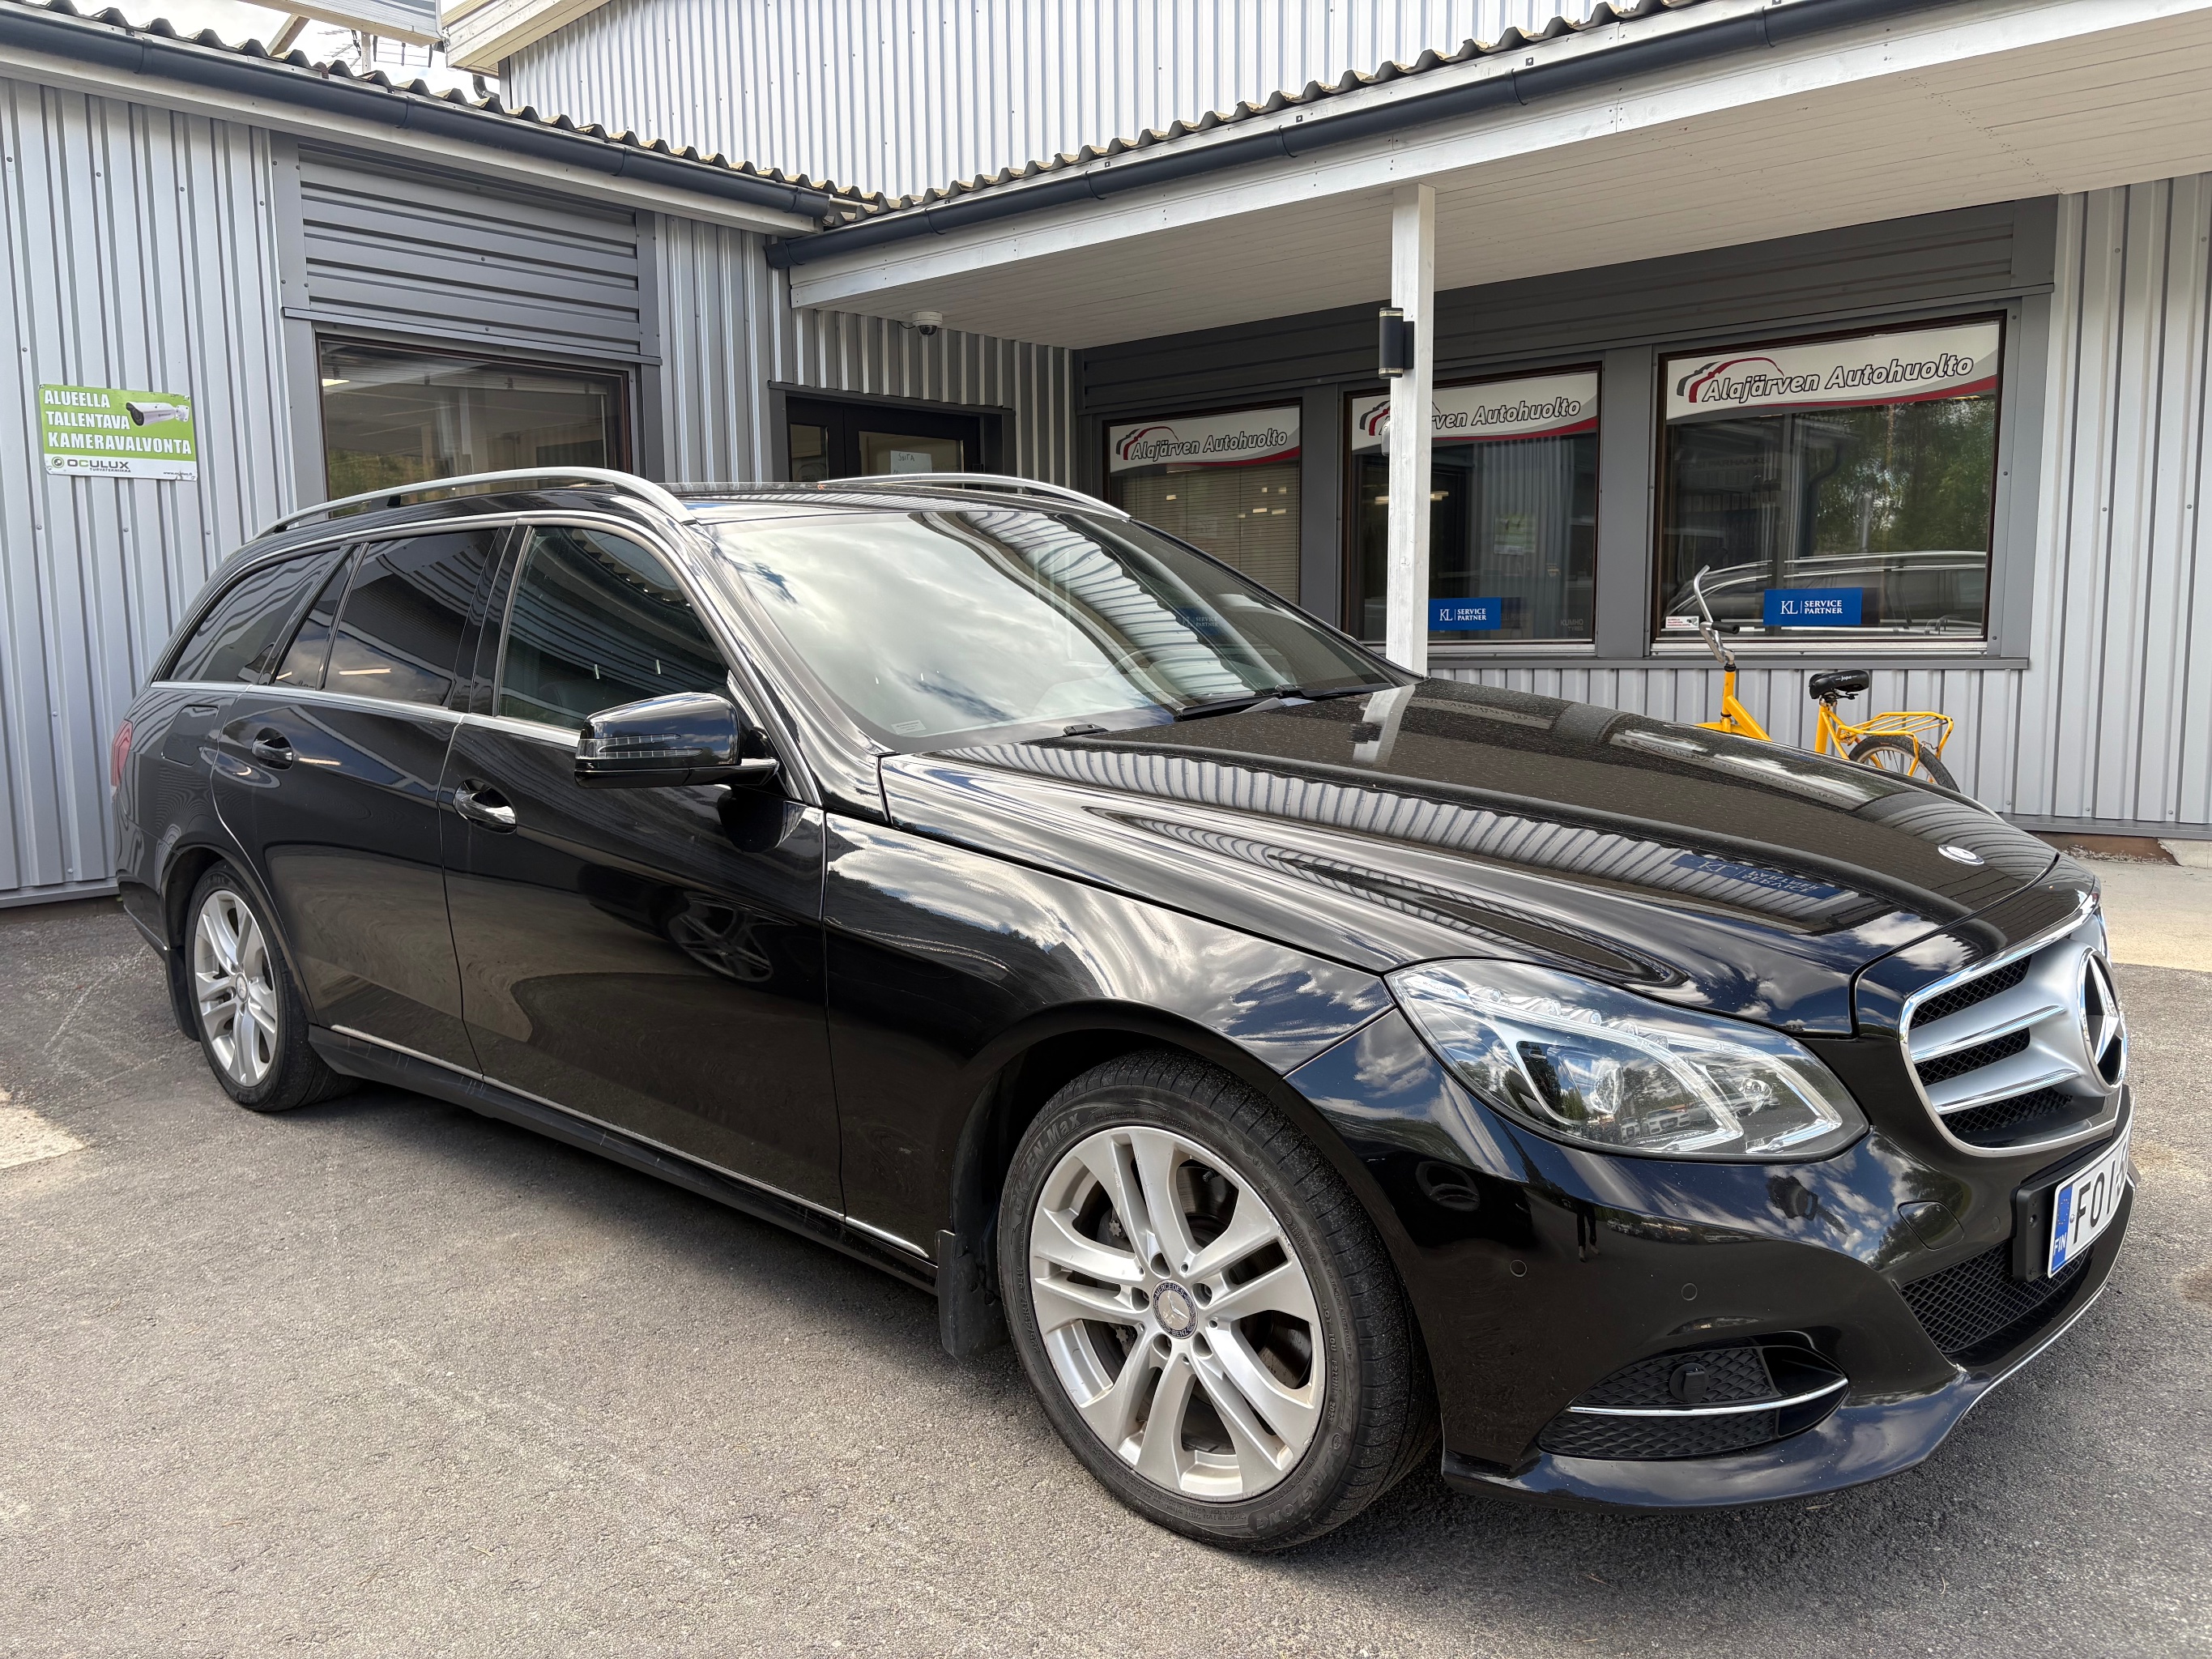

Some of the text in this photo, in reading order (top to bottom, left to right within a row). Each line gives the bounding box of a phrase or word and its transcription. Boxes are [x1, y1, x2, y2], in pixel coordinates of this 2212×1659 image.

[1702, 353, 1974, 403] Alajärven Autohuolto
[44, 390, 111, 408] ALUEELLA
[45, 411, 130, 430] TALLENTAVA
[1471, 397, 1581, 426] Autohuolto
[48, 432, 192, 454] KAMERAVALVONTA
[1131, 428, 1288, 462] Alajärven Autohuolto
[67, 458, 130, 470] OCULUX
[1439, 608, 1453, 621] KL
[1780, 599, 1842, 615] KL SERVICE
[2053, 1232, 2067, 1256] FIN
[1154, 1282, 1185, 1298] MERCEDES
[1172, 1328, 1189, 1337] BENZ
